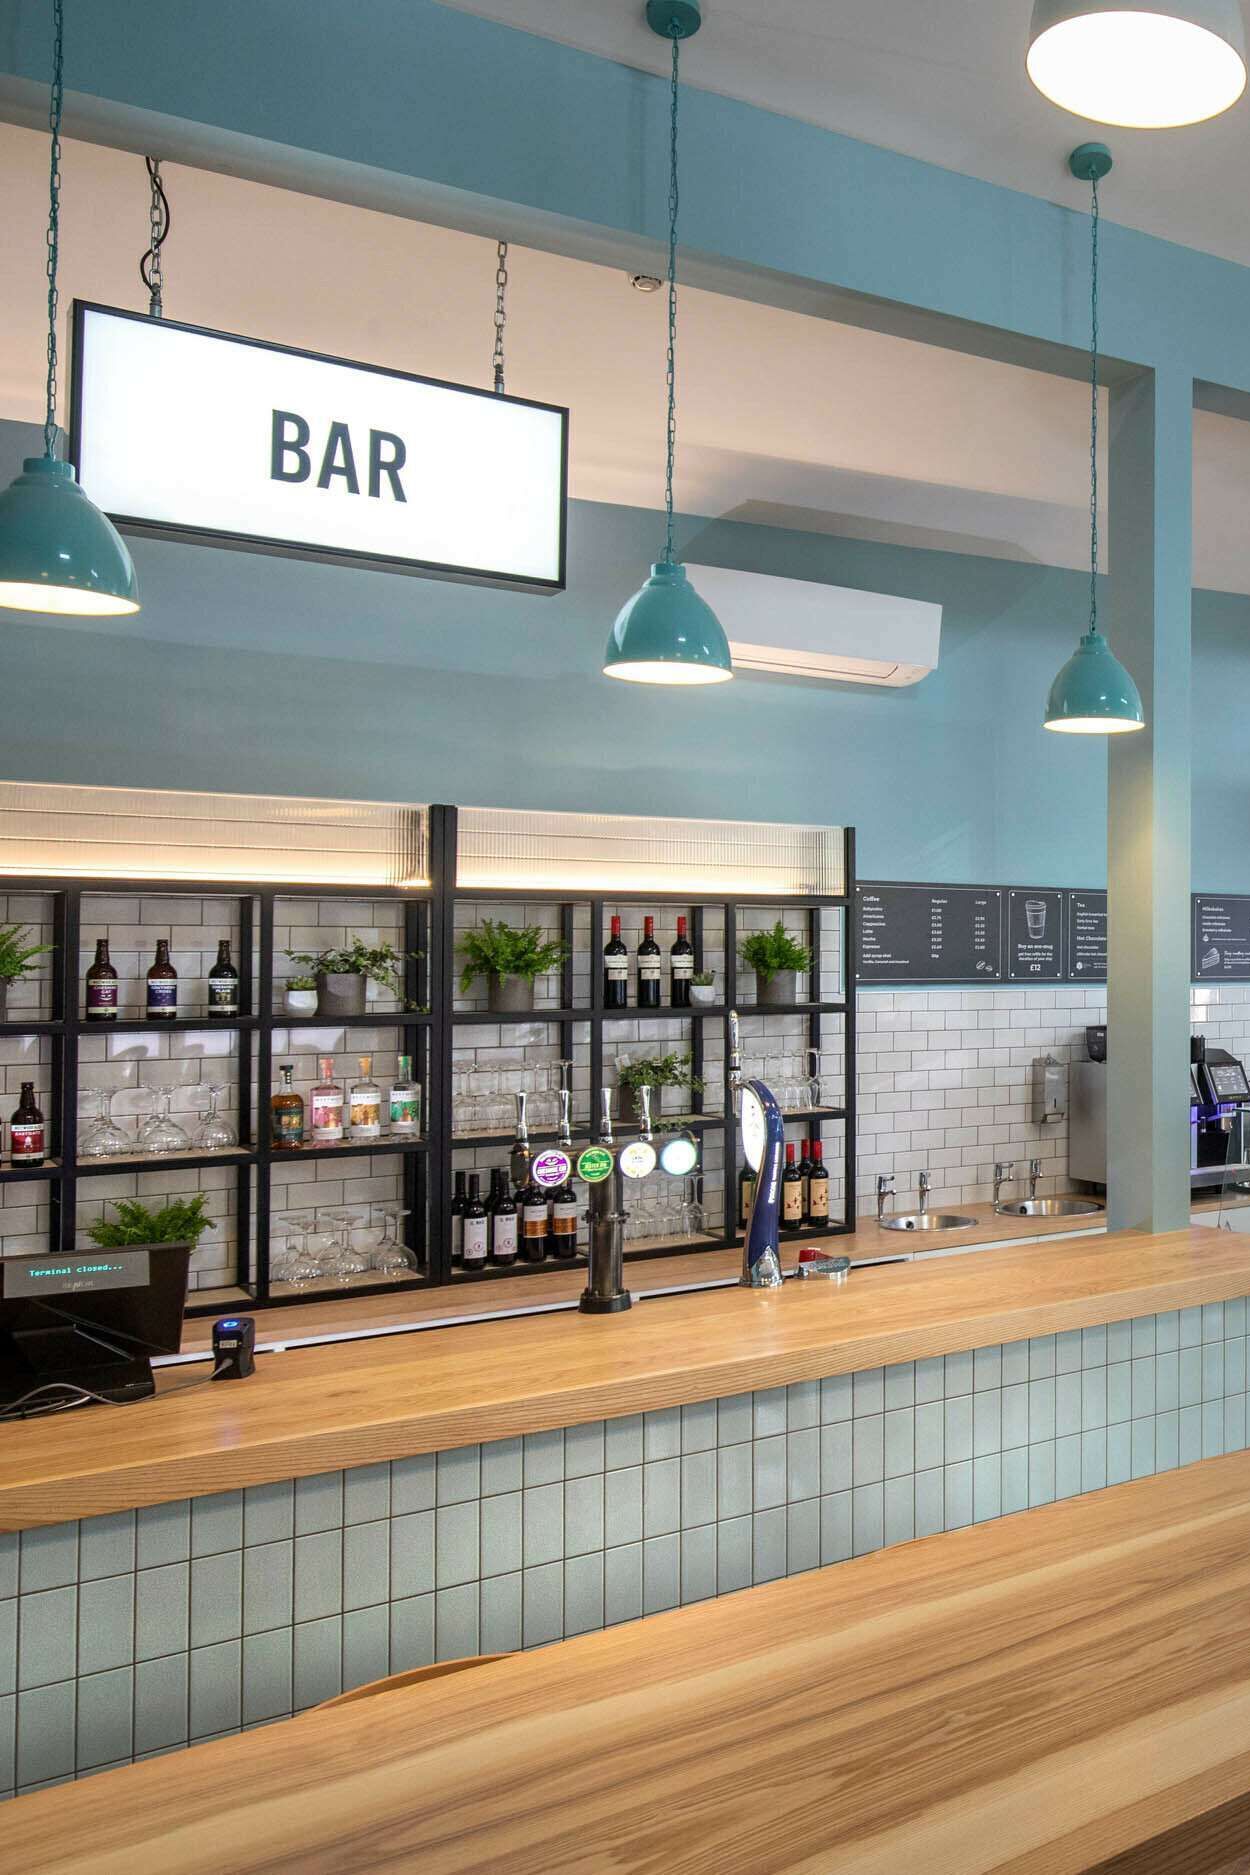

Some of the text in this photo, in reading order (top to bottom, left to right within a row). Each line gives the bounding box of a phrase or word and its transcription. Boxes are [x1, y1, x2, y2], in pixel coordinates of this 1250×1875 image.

[270, 408, 408, 504] BAR
[1030, 963, 1041, 971] £12
[29, 1264, 123, 1277] Terminal closed...
